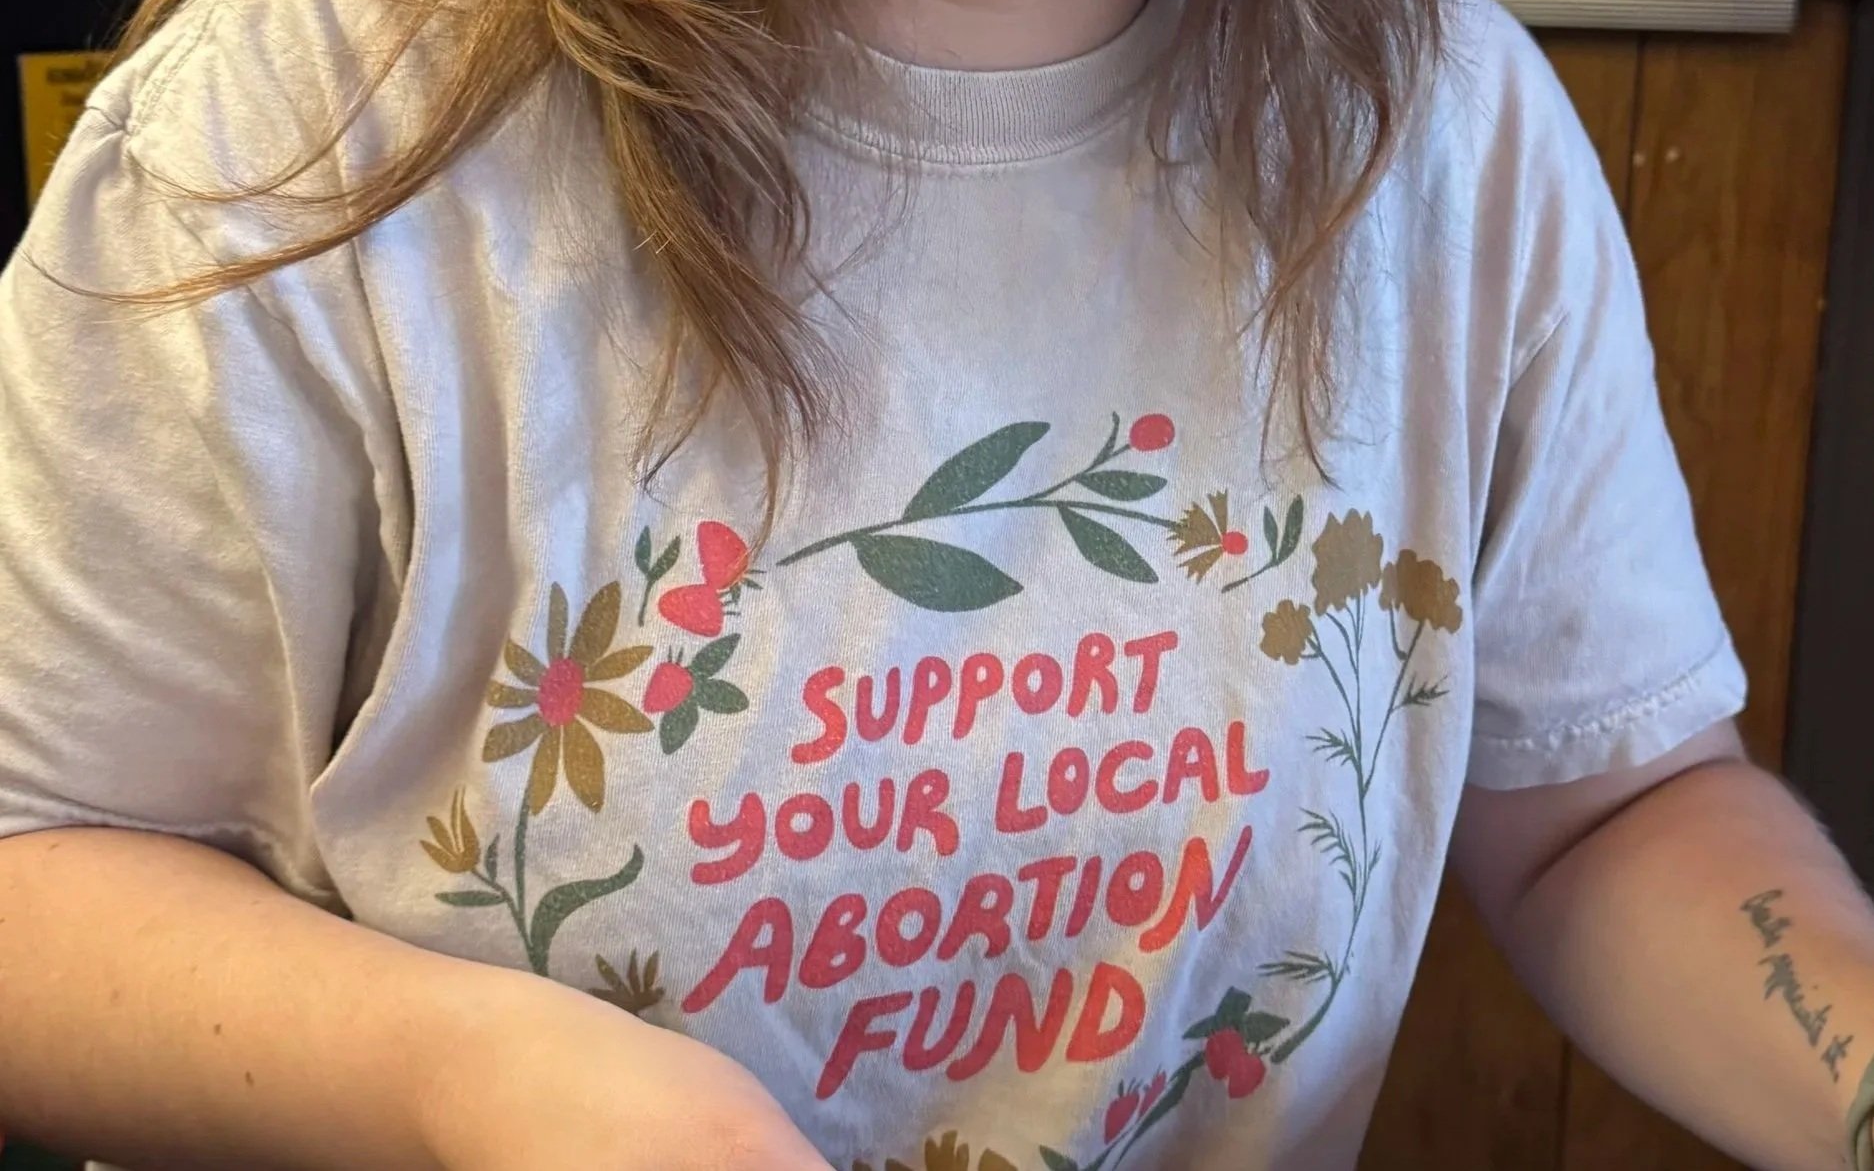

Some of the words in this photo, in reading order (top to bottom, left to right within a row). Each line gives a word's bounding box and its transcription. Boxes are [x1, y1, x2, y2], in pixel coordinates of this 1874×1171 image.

[791, 631, 1178, 764] SUPPORT
[687, 768, 960, 885] YOUR
[994, 720, 1270, 833] LOCAL
[681, 825, 1253, 1014] ABORTION
[815, 962, 1147, 1100] FUND
